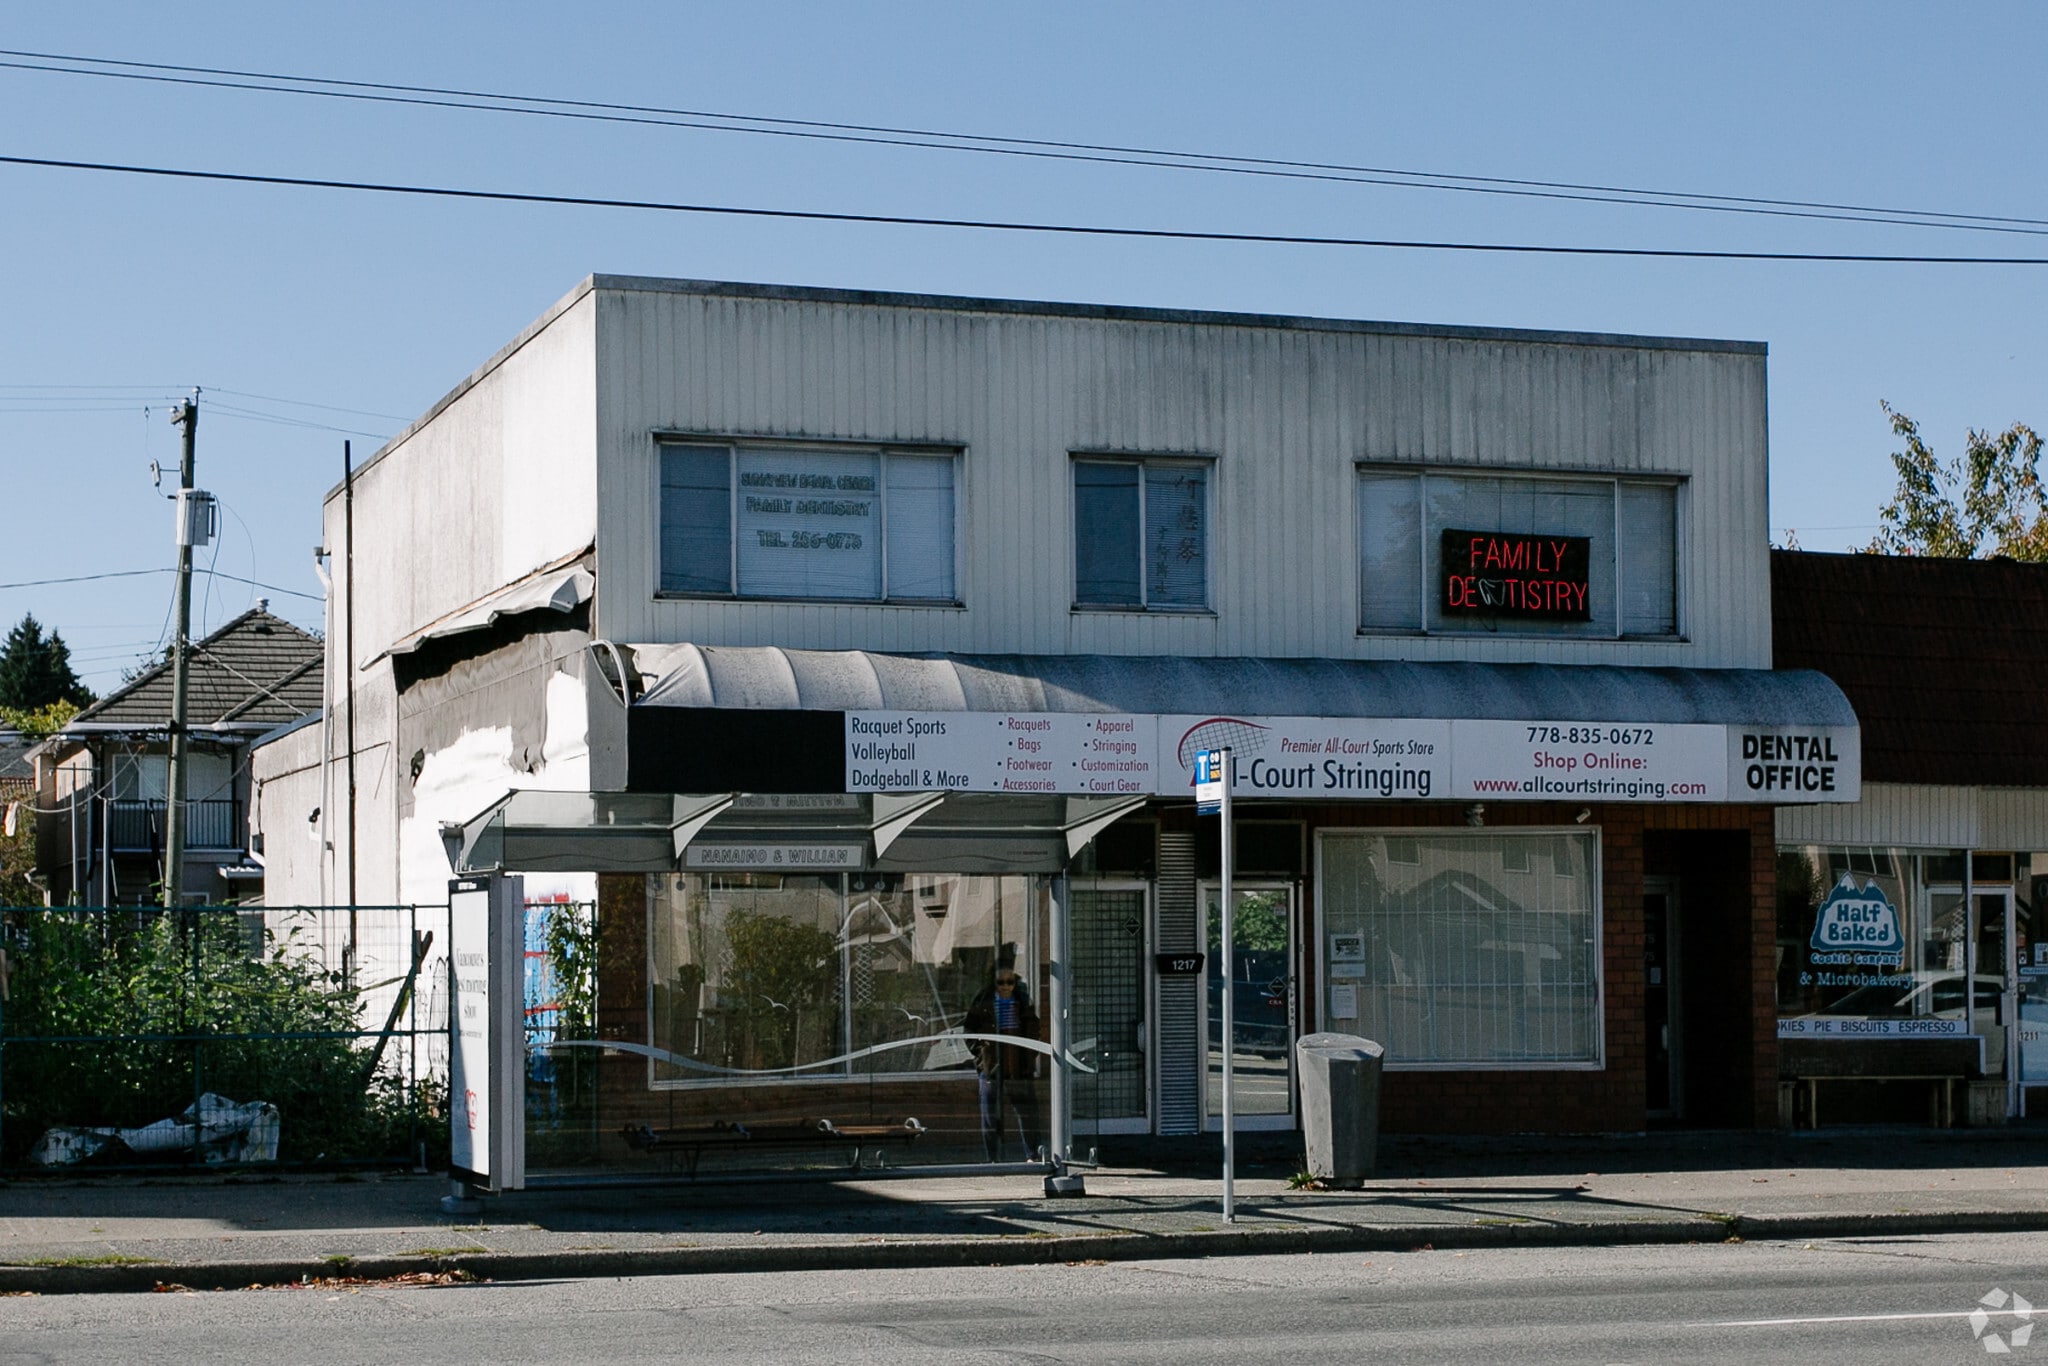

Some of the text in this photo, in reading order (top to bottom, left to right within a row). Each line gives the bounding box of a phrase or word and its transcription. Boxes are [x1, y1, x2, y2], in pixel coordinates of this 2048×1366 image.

[746, 497, 871, 517] FAMILY DENTISTRY
[1470, 537, 1568, 573] FAMILY
[851, 717, 947, 737] Racquet Sports
[1007, 717, 1051, 734] Racquets
[1095, 719, 1134, 735] Apparel
[1017, 737, 1042, 752] Bags
[1526, 726, 1654, 746] 778-835-0672
[851, 743, 916, 765] Volleyball
[1092, 738, 1137, 754] Stringing
[1281, 737, 1434, 757] Premier All-Court Sports Store
[1742, 734, 1839, 762] DENTAL
[1006, 758, 1053, 772] Footwear
[1081, 757, 1149, 773] Customization
[1533, 751, 1648, 772] Shop Online:
[852, 769, 969, 791] Dodgeball & More
[1002, 777, 1057, 792] Accessories
[1088, 778, 1141, 793] Court Gear
[1323, 759, 1432, 797] Stringing
[1473, 774, 1707, 798] www.allcourtstringing.com
[1746, 764, 1836, 792] OFFICE
[701, 849, 848, 864] NANAIMO & WILLIAM
[1836, 903, 1881, 923] Half
[1828, 923, 1889, 942] Baked
[1172, 958, 1196, 971] 1217
[1810, 952, 1905, 967] Cookie Company
[1800, 971, 1914, 990] & Microbakery
[1814, 1020, 1832, 1033] PIE
[1841, 1020, 1890, 1034] BISCUITS
[1898, 1021, 1956, 1034] ESPRESSO
